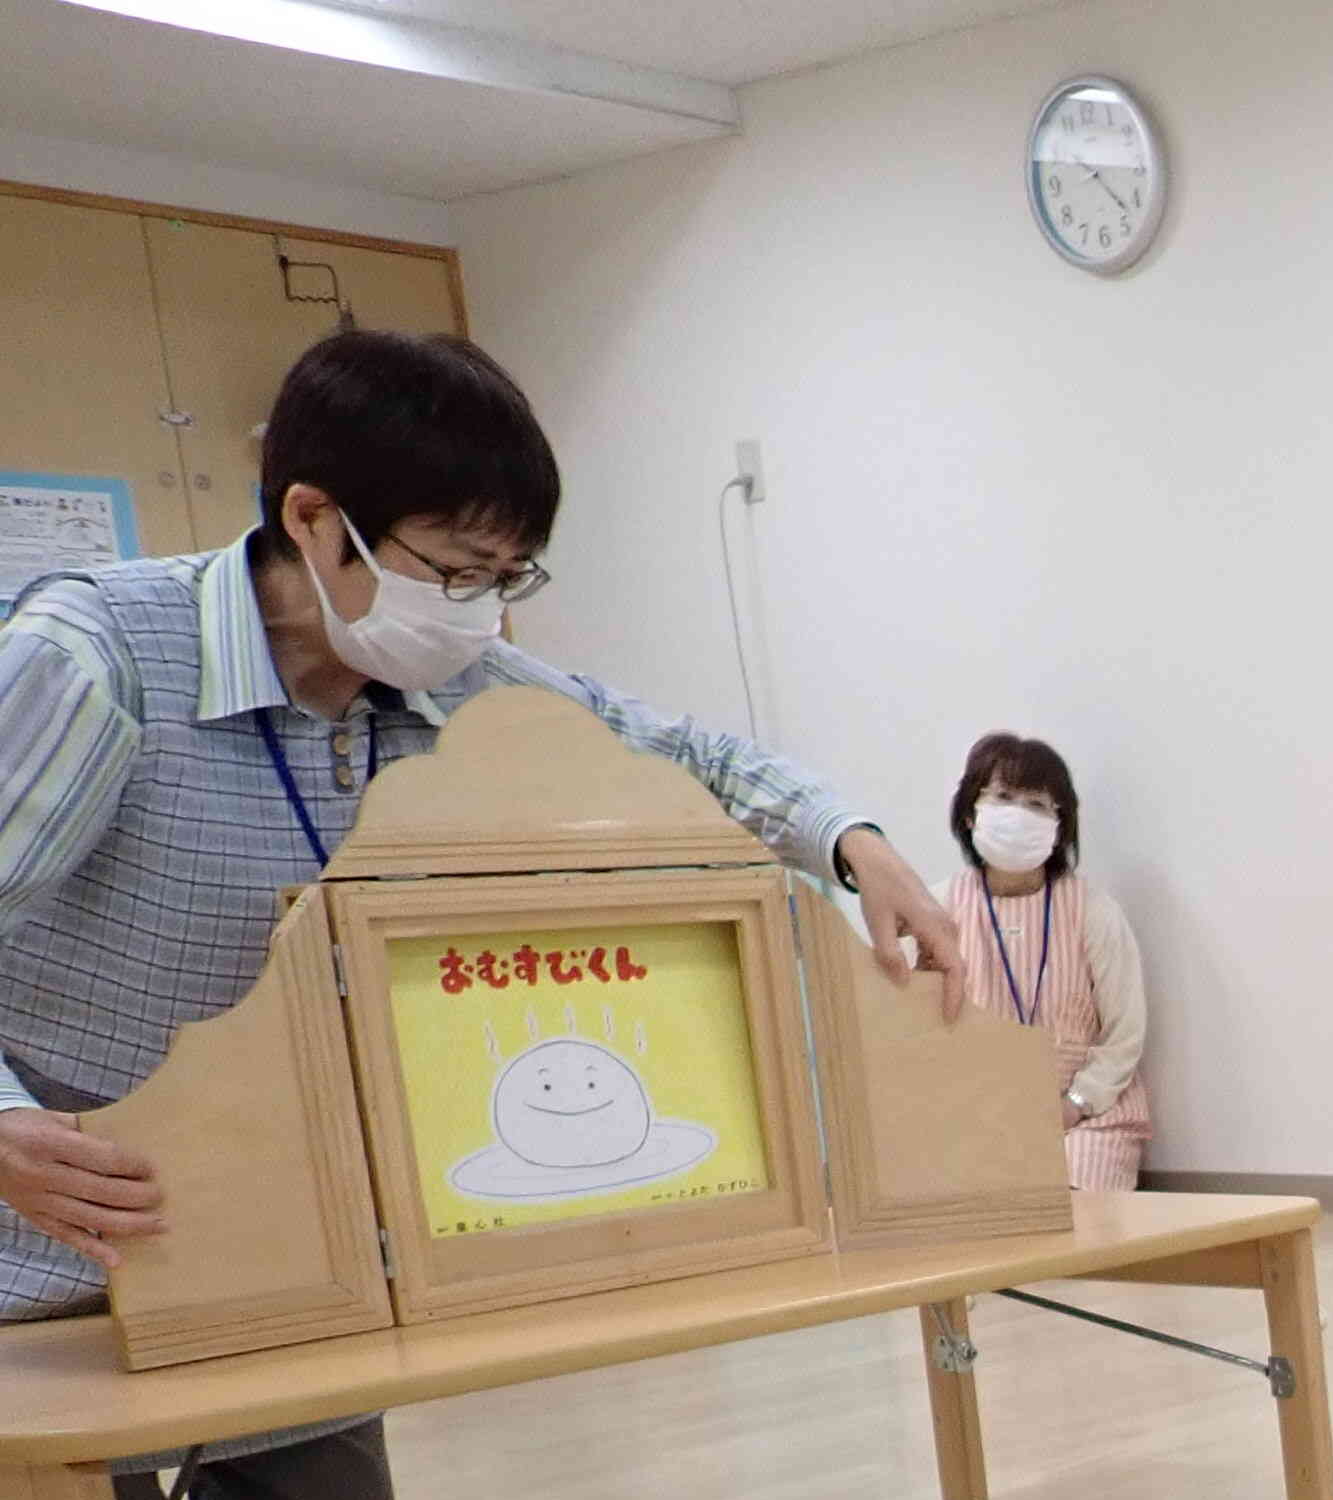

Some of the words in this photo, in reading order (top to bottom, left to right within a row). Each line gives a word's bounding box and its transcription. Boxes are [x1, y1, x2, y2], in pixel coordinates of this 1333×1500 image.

[1049, 175, 1062, 198] 9
[1061, 205, 1073, 227] 8
[1078, 222, 1089, 246] 7
[1098, 226, 1113, 248] 6
[439, 945, 647, 995] おむすびくん
